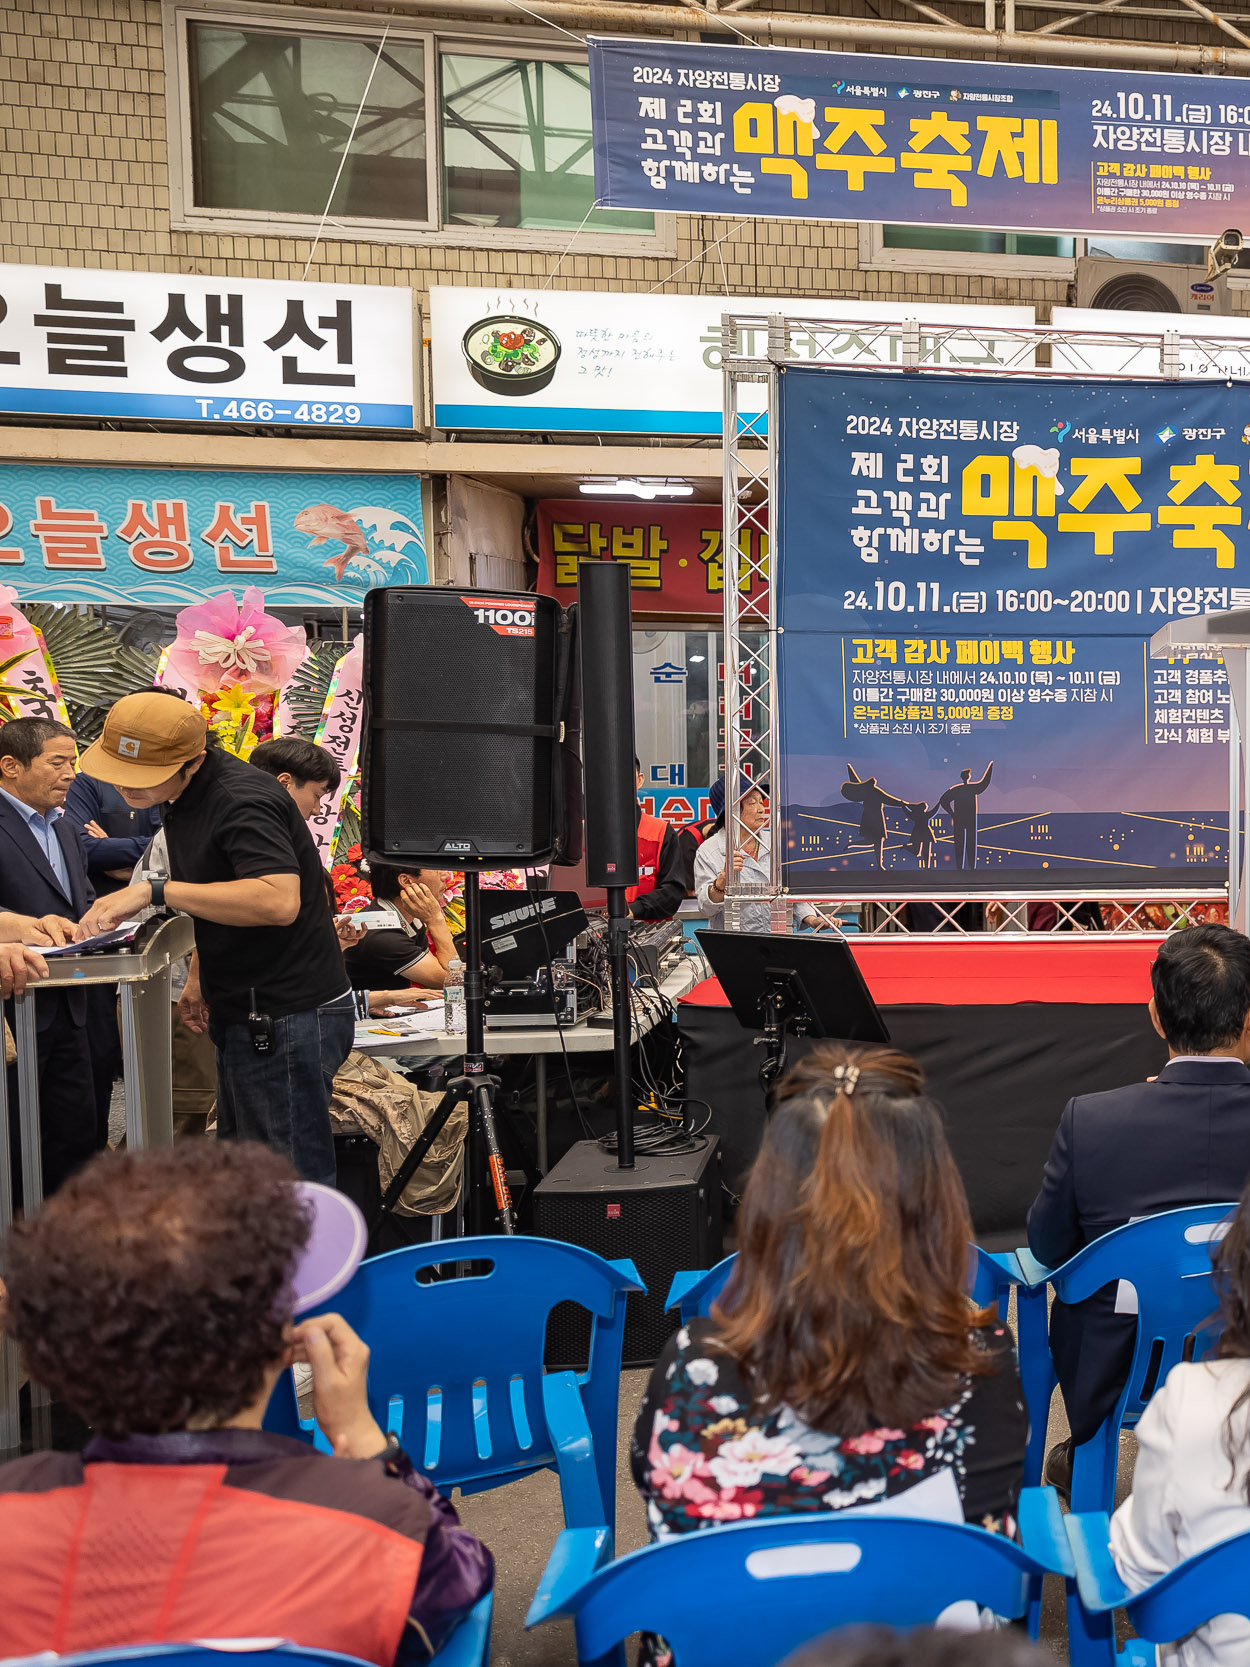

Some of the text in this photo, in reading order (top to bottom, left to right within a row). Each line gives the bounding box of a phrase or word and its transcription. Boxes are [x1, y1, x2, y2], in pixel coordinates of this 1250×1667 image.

[632, 66, 781, 93] 2024 자양전통시장
[846, 84, 887, 98] 서울특별시
[912, 88, 940, 100] 광진구
[962, 92, 1014, 104] 자양전통시장조합
[638, 96, 666, 120] 제
[641, 127, 725, 161] 고객과
[1092, 125, 1232, 157] 자양전통시장
[641, 158, 755, 194] 함께하는
[1096, 161, 1212, 180] 고객 감사 페이백 행사
[1097, 178, 1138, 188] 자양전통시장
[1161, 180, 1186, 190] 24.10.10
[1207, 182, 1221, 191] 10.11
[1171, 191, 1185, 199] 이상
[578, 366, 587, 374] 그
[195, 398, 361, 424] T.466-4829
[846, 415, 1019, 442] 2024 자양전통시장
[1071, 427, 1140, 446] 서울특별시
[1182, 427, 1226, 441] 광진구
[850, 452, 949, 484] 제 2회
[851, 490, 951, 527] 고객과
[851, 526, 985, 566] 함께하는
[997, 589, 1130, 614] 16:00~20:00
[506, 627, 533, 635] TS215
[852, 639, 1076, 665] 고객 감사 페이백 행사
[852, 670, 1120, 685] 자양전통시장 내에서 24.10.10 (목) 10.11 (금)
[1153, 669, 1182, 685] 고객
[852, 688, 1113, 703] 이틀간 구매한 30,000원 이상 영수증 지참 시
[1153, 689, 1213, 705] 고객 참여
[853, 705, 1014, 720] 온누리상품권 5,000원 증정
[1154, 708, 1224, 724] 체험컨텐츠
[892, 723, 913, 735] 소진
[915, 723, 926, 735] 시
[928, 723, 948, 735] 조기
[950, 723, 971, 735] 종료
[1154, 728, 1213, 744] 간식 체험
